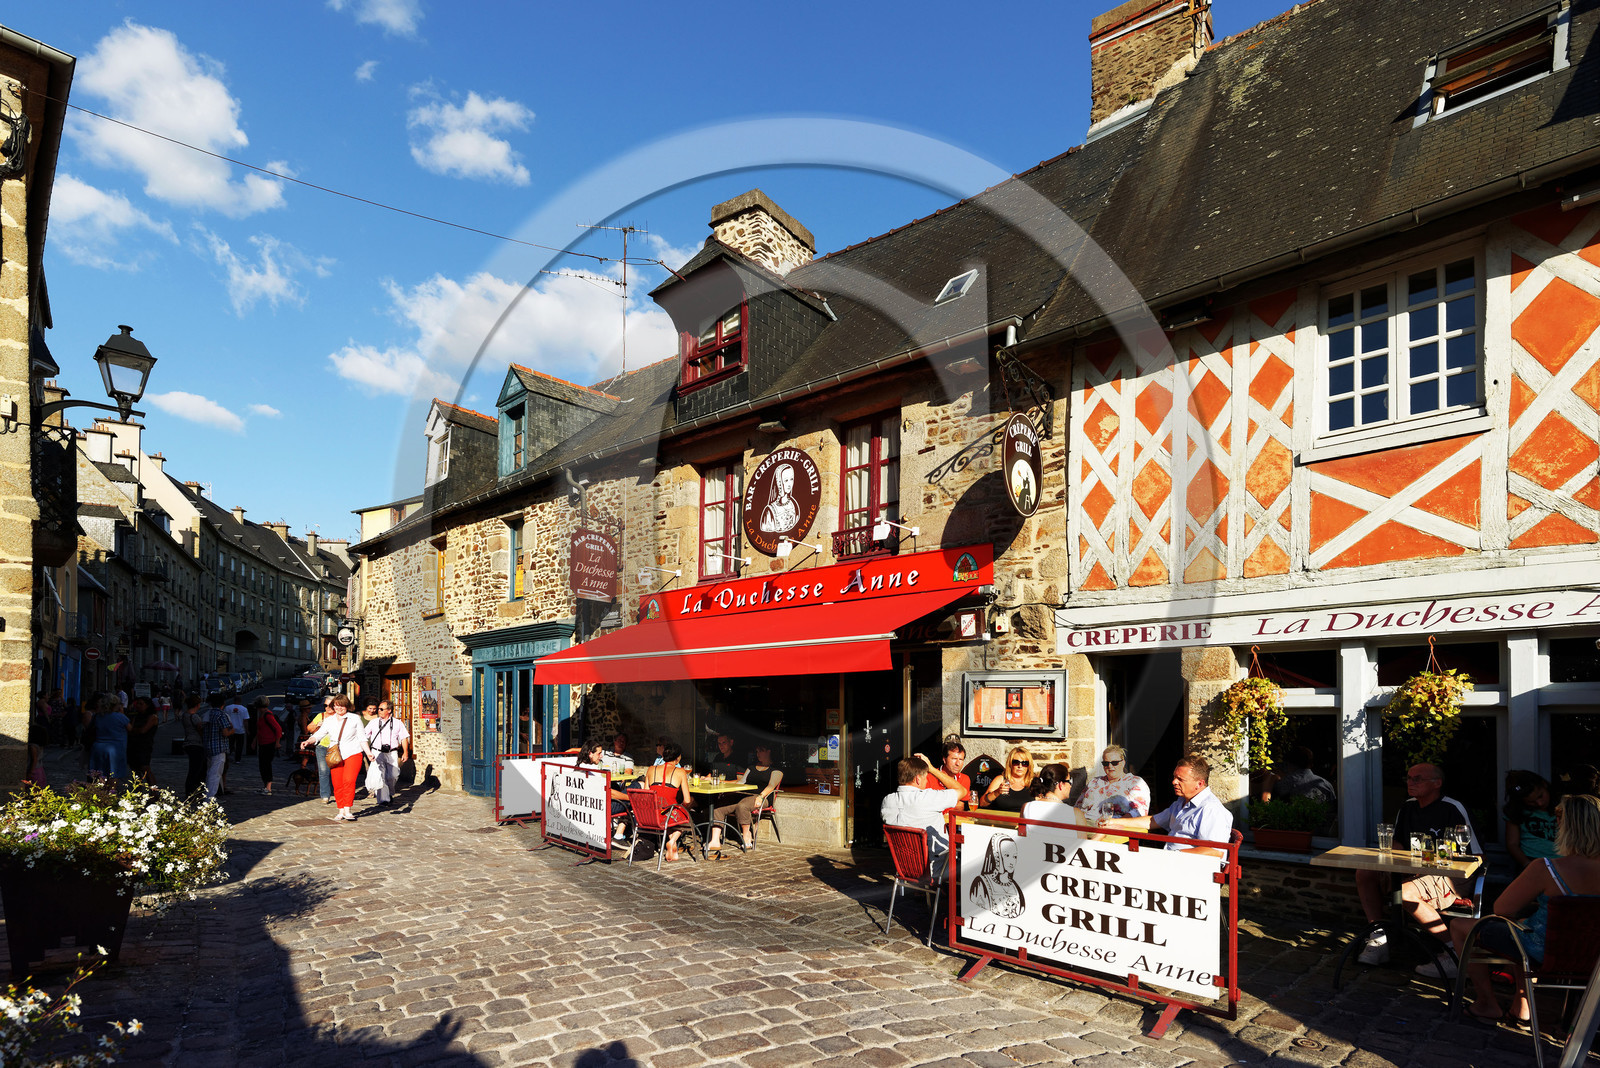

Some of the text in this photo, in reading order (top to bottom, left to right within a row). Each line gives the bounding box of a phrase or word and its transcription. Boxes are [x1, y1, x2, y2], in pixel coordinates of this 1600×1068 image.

[1015, 440, 1033, 457] GRILL
[746, 518, 755, 535] La
[797, 504, 817, 537] Anne
[585, 542, 605, 552] GRILL
[588, 552, 601, 563] La
[574, 561, 615, 579] Duchesse
[581, 577, 609, 590] Anne
[680, 568, 920, 615] La Duchesse Anne
[1252, 617, 1310, 636] La
[1320, 600, 1555, 632] Duchesse
[1066, 621, 1213, 648] CREPERIE
[565, 775, 585, 790] BAR
[564, 791, 604, 811] CREPERIE
[565, 807, 595, 826] GRILL
[547, 819, 555, 828] La
[556, 821, 585, 838] Duchesse
[1043, 842, 1124, 875] BAR
[1040, 872, 1209, 922] CREPERIE
[1041, 903, 1168, 948] GRILL
[966, 916, 1213, 987] La Duchesse Anne
